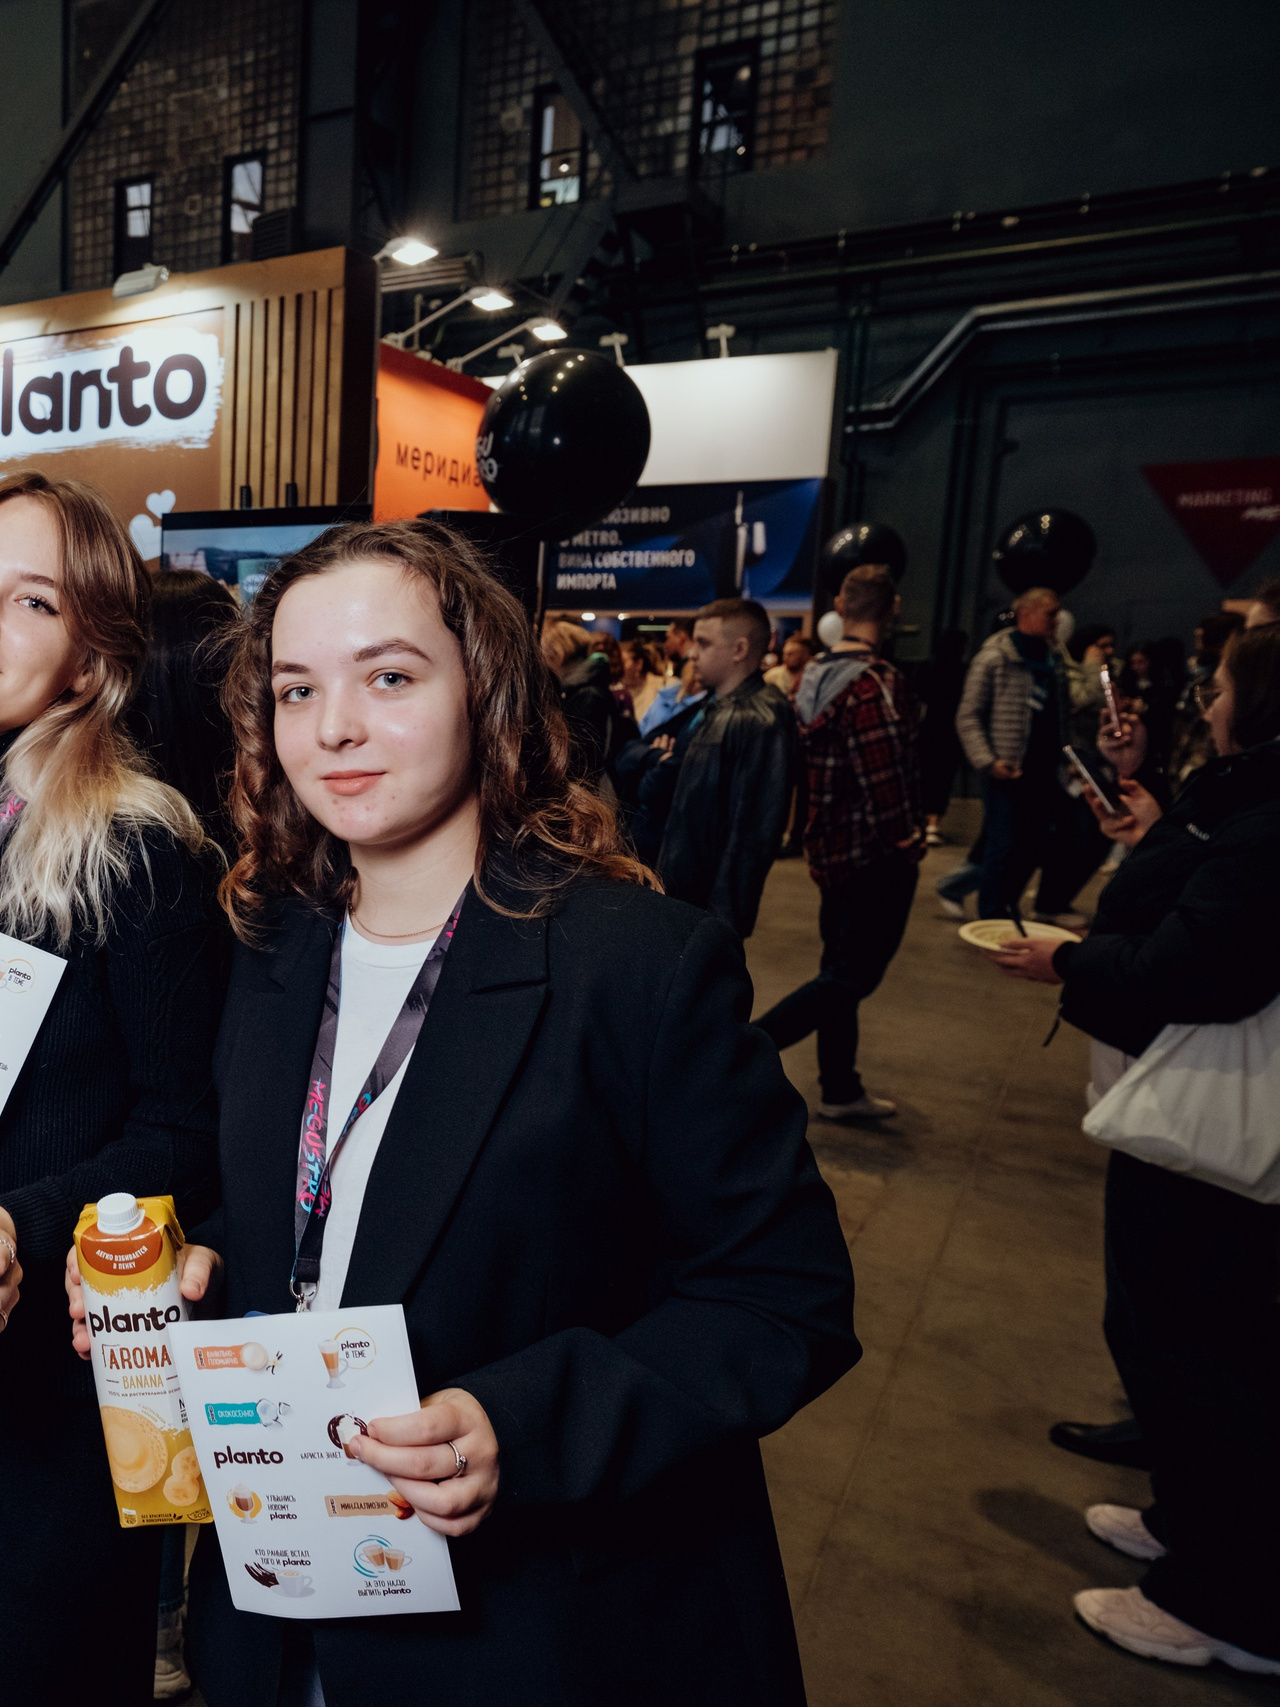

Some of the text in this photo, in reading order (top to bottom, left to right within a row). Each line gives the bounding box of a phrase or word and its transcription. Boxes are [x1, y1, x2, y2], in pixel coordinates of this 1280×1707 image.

[396, 442, 483, 489] меридиа
[594, 549, 696, 568] СОБСТВЕННОГО
[556, 573, 617, 590] ИМПОРТА
[8, 967, 32, 981] planto
[96, 1244, 148, 1262] ЛЕГКО ВЗБИВАЕТСЯ
[112, 1261, 136, 1270] В ПЕНКУ
[88, 1305, 181, 1338] planto
[341, 1341, 370, 1352] planto
[109, 1344, 172, 1370] AROMA
[351, 1350, 366, 1358] ТЕМЕ
[122, 1374, 164, 1390] BANANA
[129, 1389, 168, 1398] растительной
[168, 1387, 181, 1395] осно
[213, 1445, 284, 1469] planto
[300, 1451, 324, 1460] БАРИСТА
[265, 1494, 297, 1503] УЛЫБНИСЬ
[269, 1511, 298, 1521] planto
[254, 1549, 265, 1557] КТО
[266, 1549, 288, 1557] РАНЬШЕ
[260, 1557, 275, 1565] ТОГО
[282, 1558, 312, 1567] planto
[364, 1579, 406, 1588] ЗА ЭТО НАДО
[357, 1587, 412, 1597] ВЫПИТЬ planto
